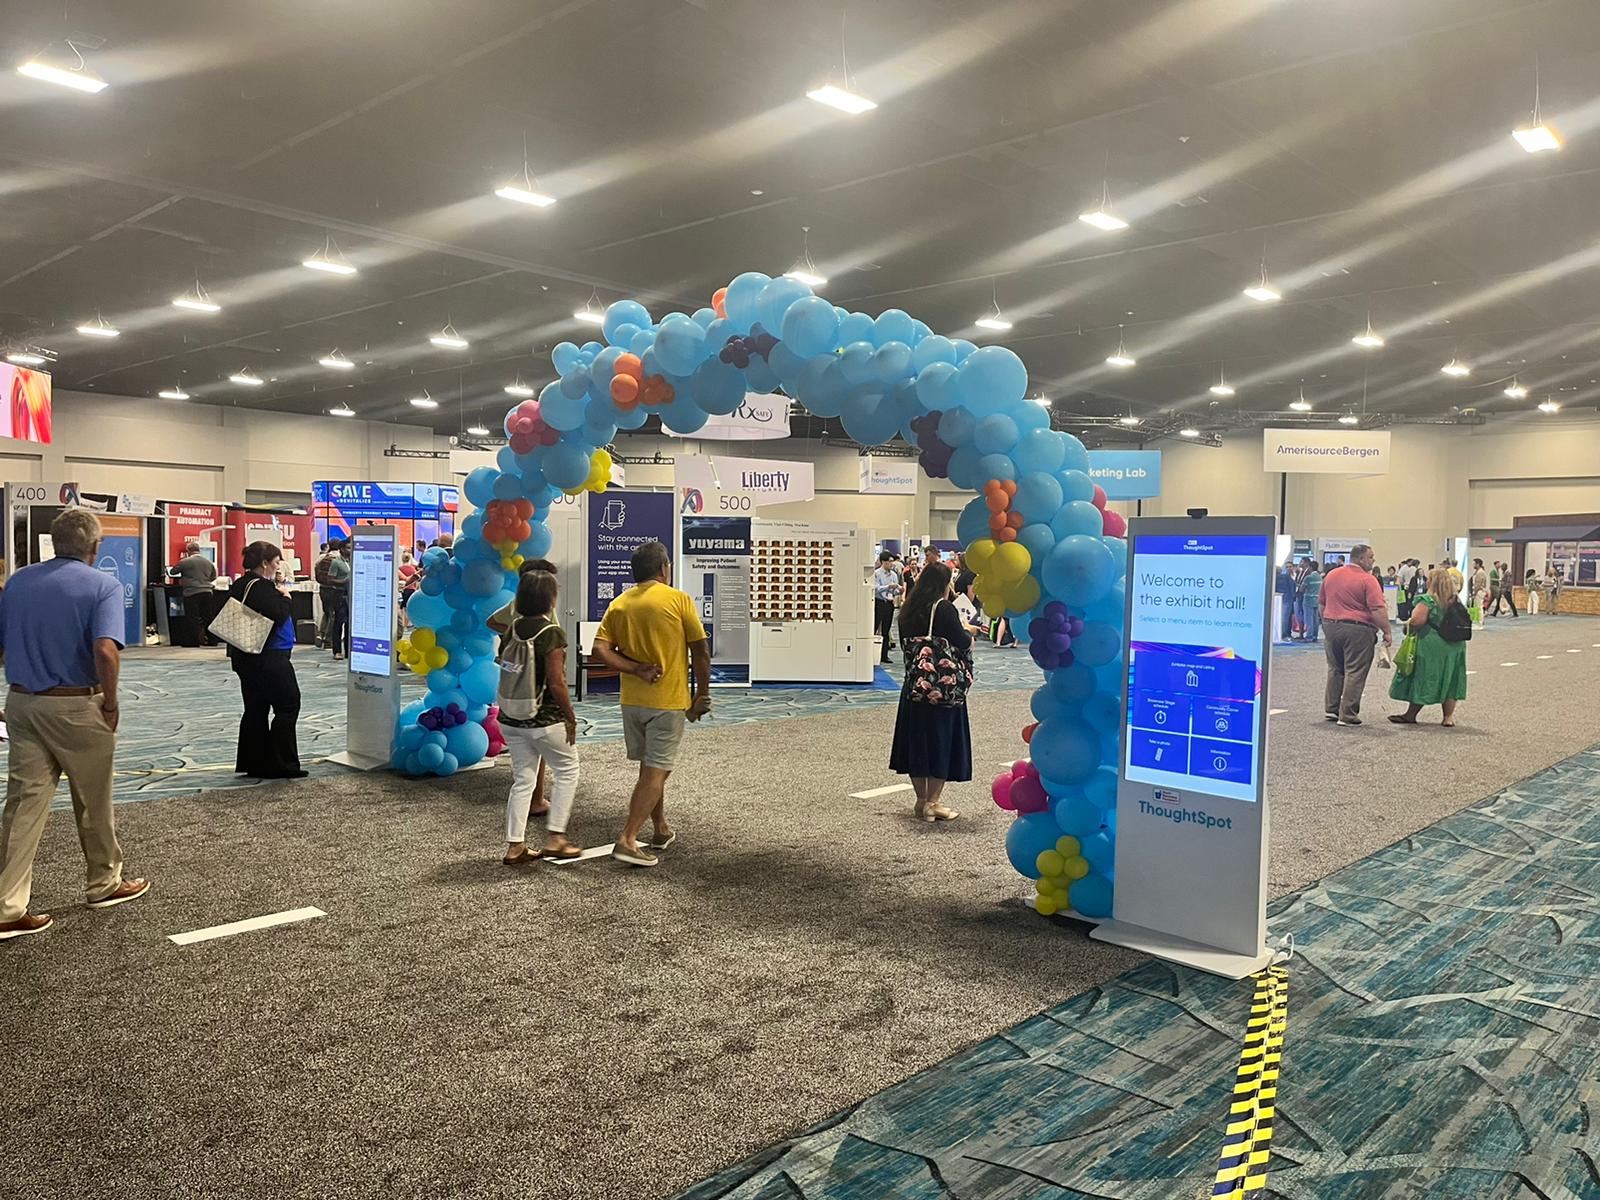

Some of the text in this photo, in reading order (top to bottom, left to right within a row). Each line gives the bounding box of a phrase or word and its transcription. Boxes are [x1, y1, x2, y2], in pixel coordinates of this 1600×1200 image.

[1277, 445, 1380, 458] AmerisourceBergen
[1088, 467, 1147, 480] keting Lab
[741, 471, 790, 492] Liberty
[871, 476, 913, 485] houghtSpot
[16, 487, 47, 502] 400
[331, 485, 372, 498] SAVE
[720, 495, 751, 511] 500
[179, 507, 212, 516] PHARMACY
[176, 517, 215, 526] AUTOMATION
[598, 534, 659, 543] Stay connected
[689, 538, 745, 550] yuyama
[1140, 573, 1224, 589] Welcome to
[1140, 593, 1246, 610] the exhibit hall!
[1140, 614, 1160, 623] Select
[1167, 617, 1187, 625] menu
[1187, 618, 1204, 626] item
[1204, 618, 1213, 626] to
[1213, 618, 1233, 627] learn
[1138, 800, 1232, 830] ThoughtSpot
